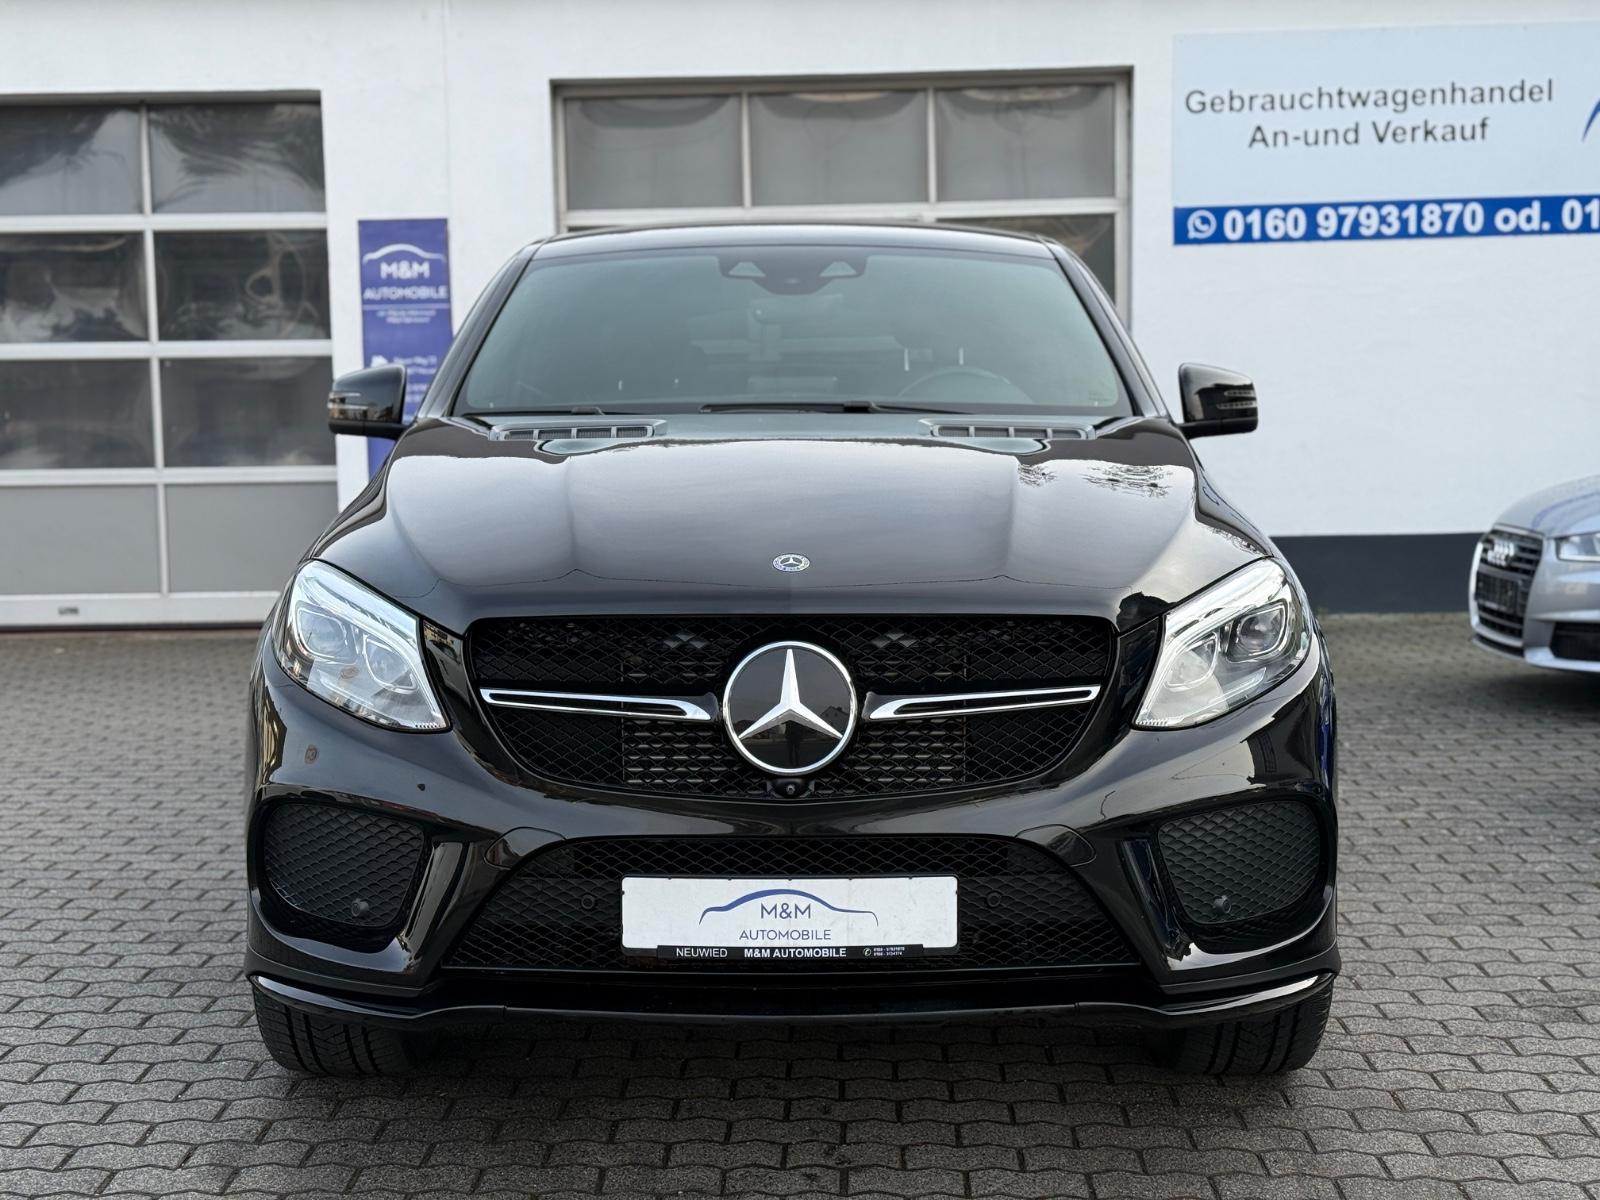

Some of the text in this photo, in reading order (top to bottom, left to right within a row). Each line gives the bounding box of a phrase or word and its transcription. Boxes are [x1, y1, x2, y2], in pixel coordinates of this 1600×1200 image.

[1185, 79, 1553, 114] Gebrauchtwagenhandel
[1249, 117, 1490, 149] An-und Verkauf
[1223, 208, 1306, 240] 0160
[1316, 202, 1484, 236] 97931870
[1494, 199, 1550, 232] od.
[380, 260, 430, 279] M&M
[363, 285, 448, 300] AUTOMOBILE
[760, 903, 811, 920] M&M
[739, 929, 831, 941] AUTOMOBILE
[676, 948, 728, 958] NEUWIED
[744, 948, 847, 959] M&M AUTOMOBILE
